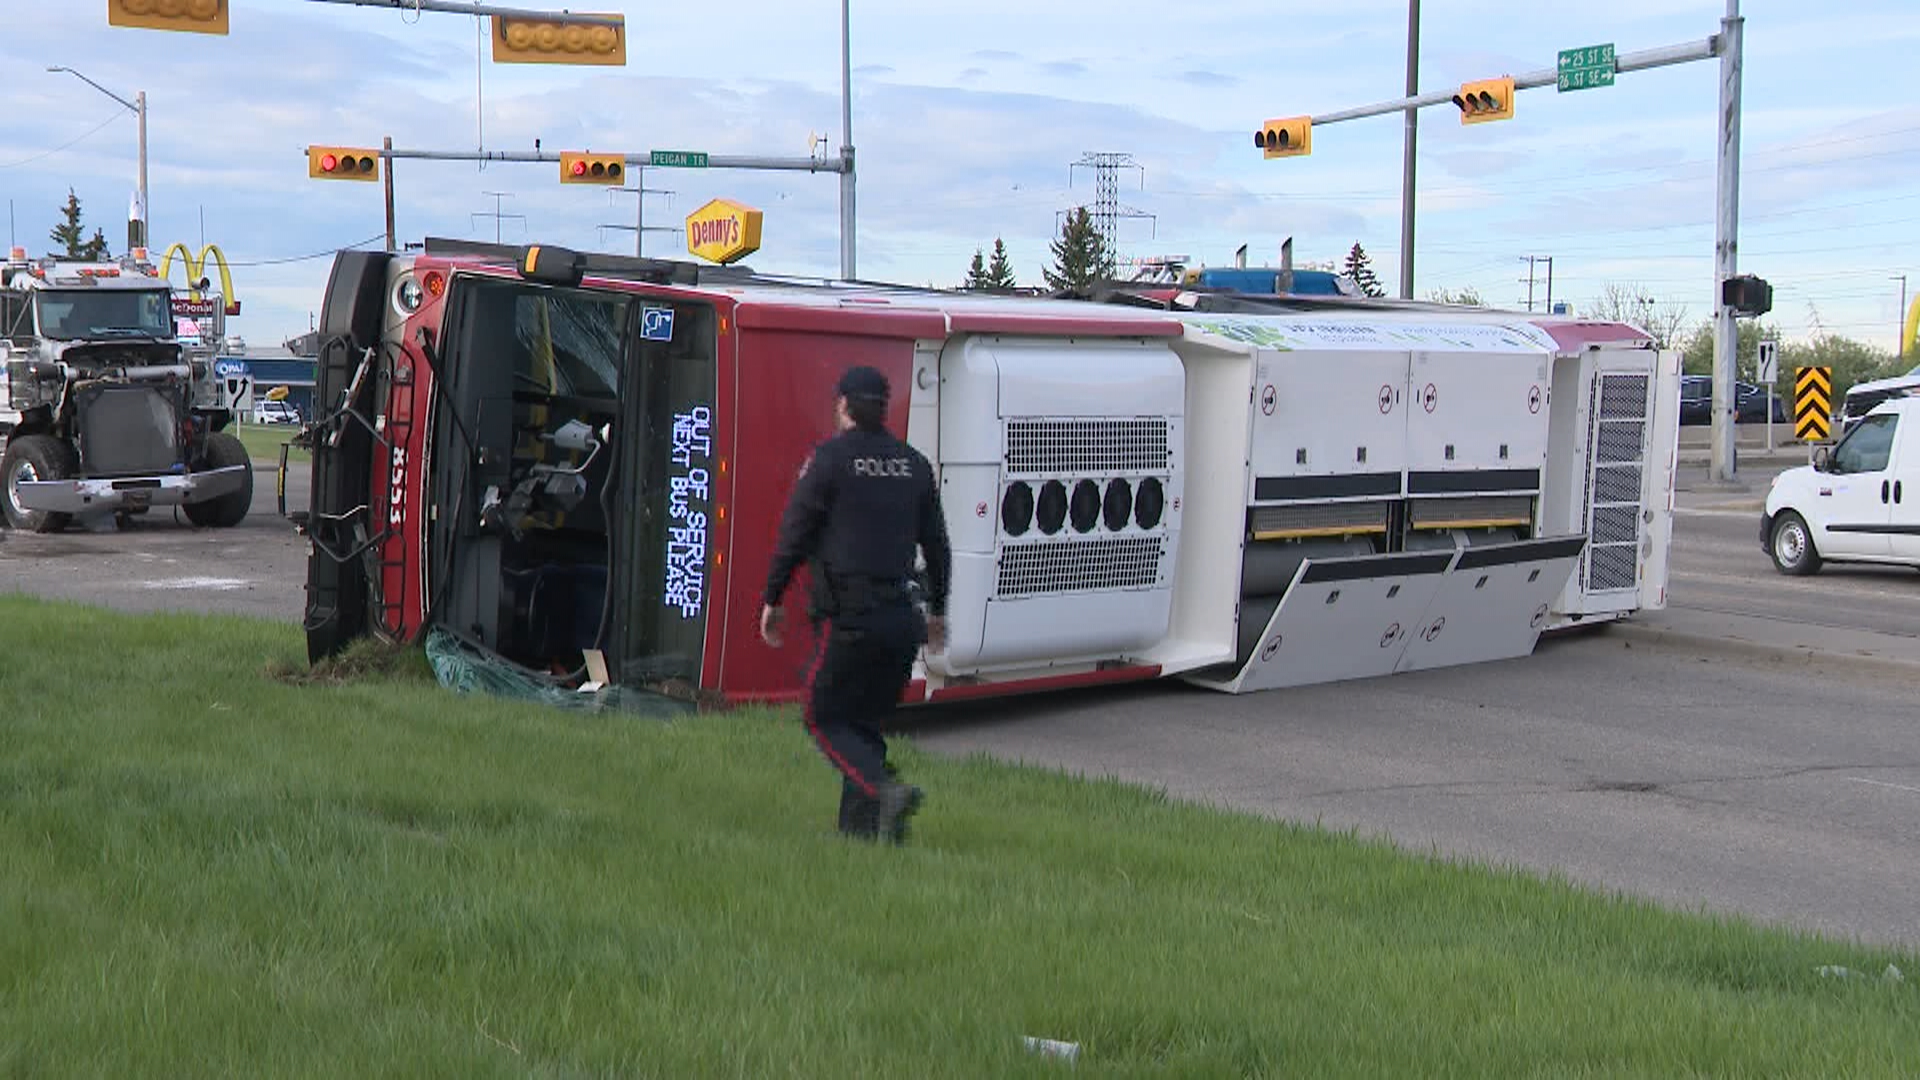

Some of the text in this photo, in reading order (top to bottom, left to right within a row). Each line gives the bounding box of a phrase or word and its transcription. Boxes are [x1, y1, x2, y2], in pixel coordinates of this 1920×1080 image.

[1572, 47, 1613, 67] 25 ST SE
[1559, 69, 1600, 89] 26 ST SE
[653, 152, 706, 167] PEIGAN TR
[691, 213, 740, 249] Denny's
[854, 458, 914, 477] POLICE
[665, 413, 692, 607] NEXT BUS PLEASE
[682, 406, 711, 618] OUT OF SERVICE
